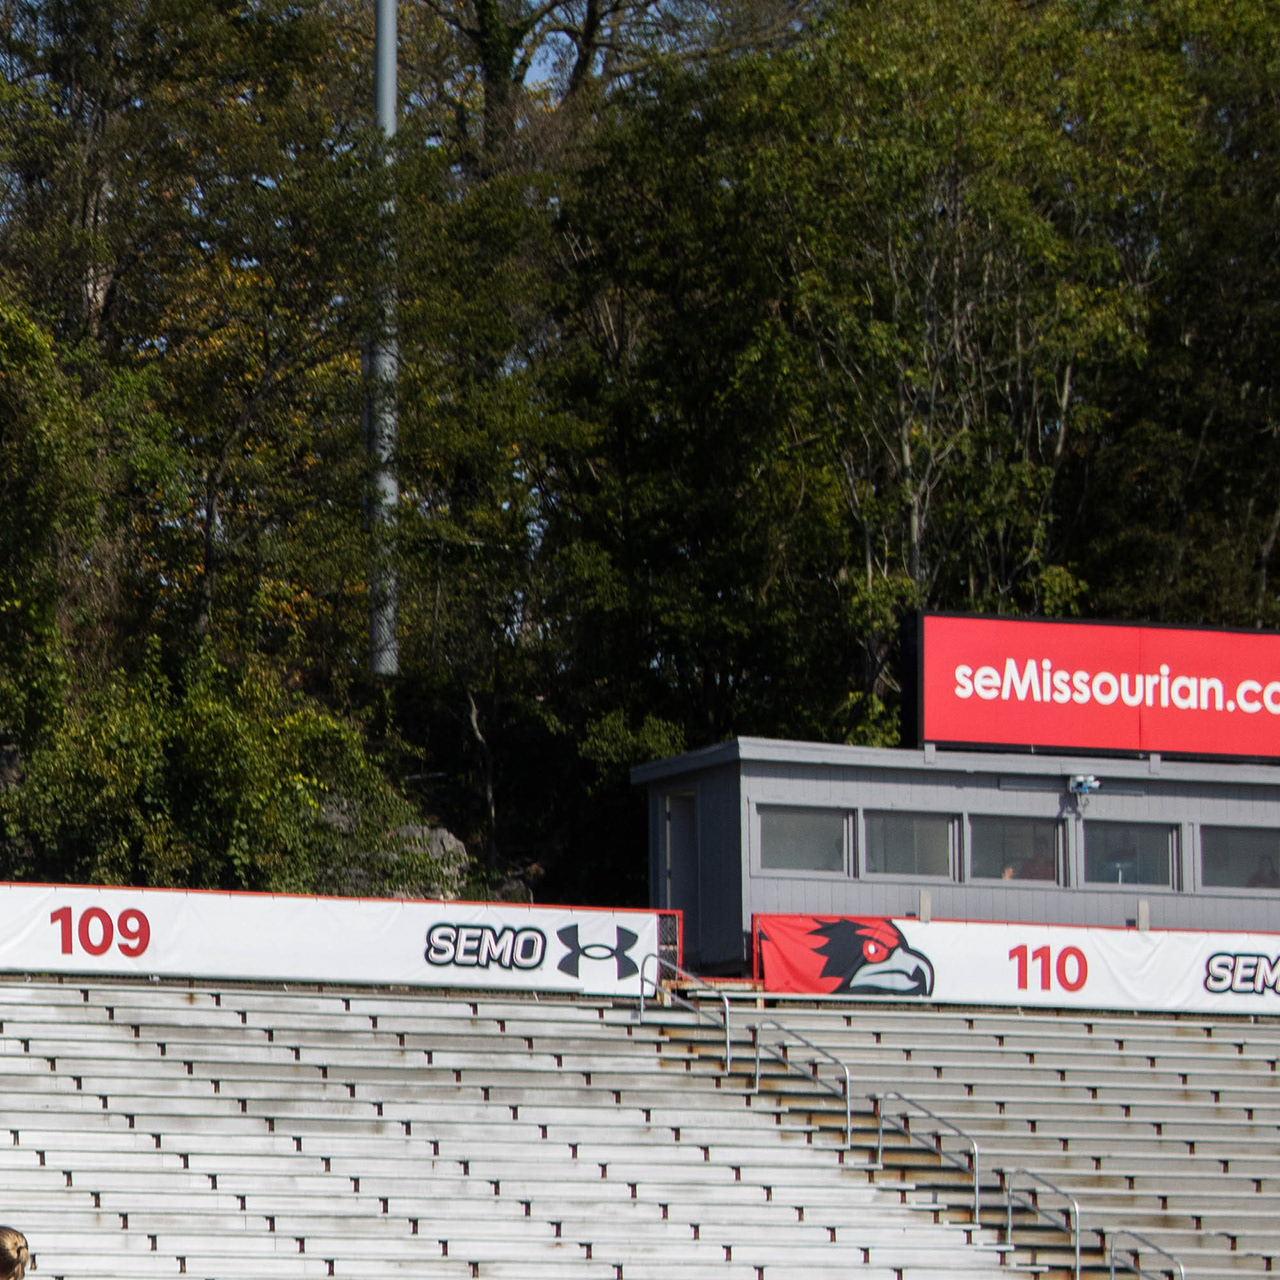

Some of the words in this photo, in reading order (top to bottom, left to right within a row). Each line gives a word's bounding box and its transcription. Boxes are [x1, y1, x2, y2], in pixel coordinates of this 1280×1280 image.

[50, 906, 151, 958] 109
[424, 922, 547, 970] SEMO
[1008, 944, 1088, 992] 110
